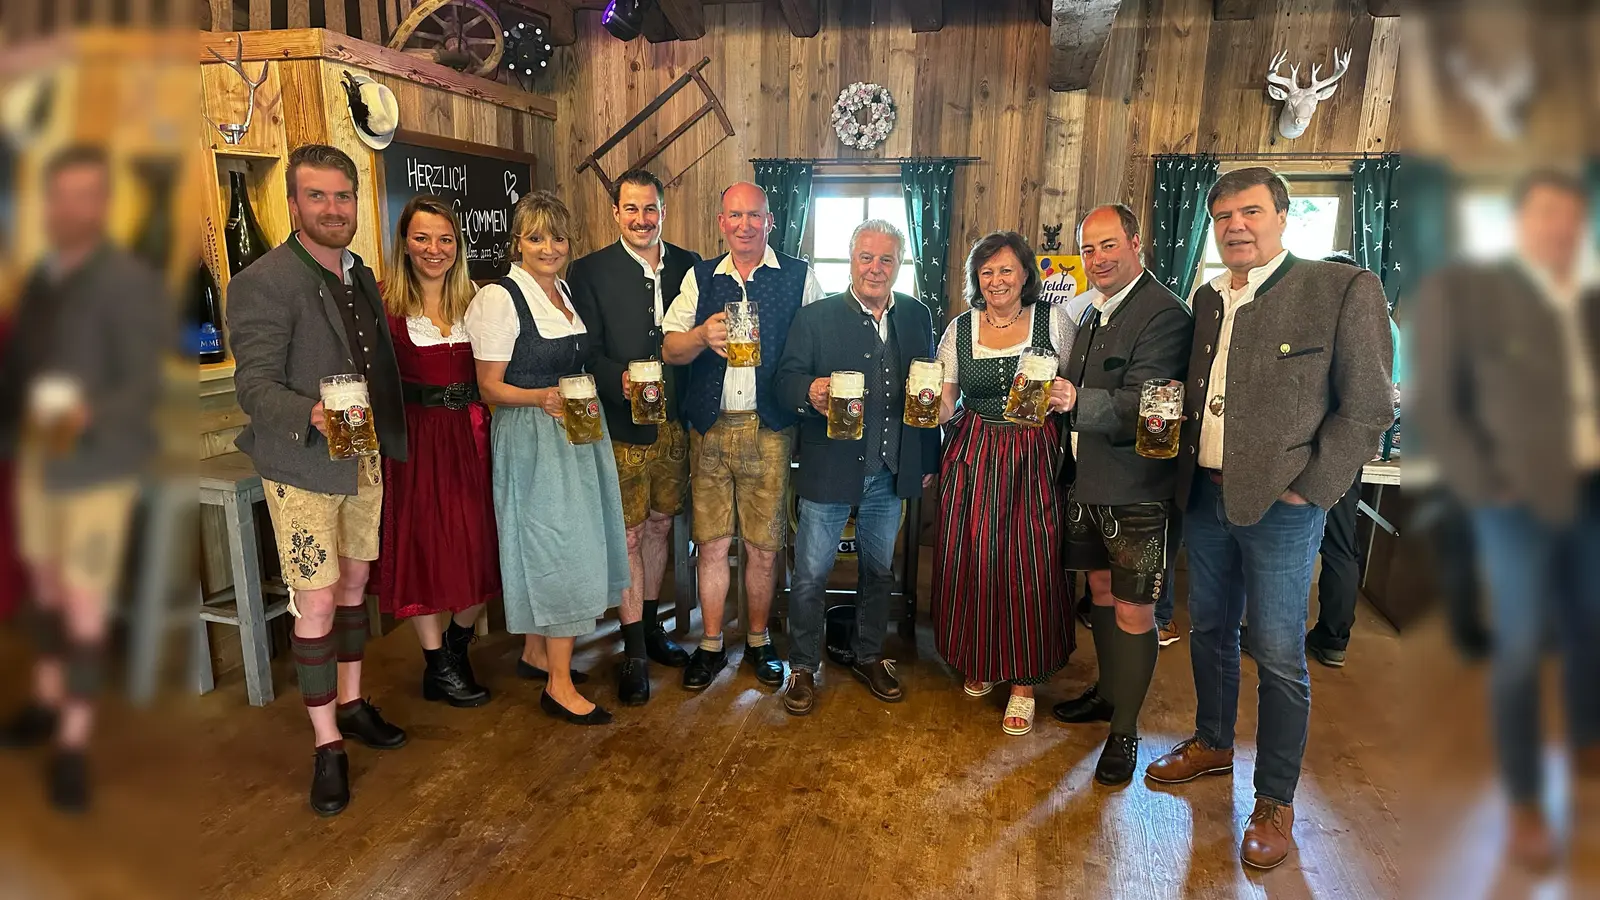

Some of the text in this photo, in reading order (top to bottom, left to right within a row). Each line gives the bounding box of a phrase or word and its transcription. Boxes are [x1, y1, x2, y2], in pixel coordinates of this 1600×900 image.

[407, 157, 467, 196] HERZLICH
[453, 199, 507, 244] LKOMMEN
[1043, 280, 1075, 293] felder
